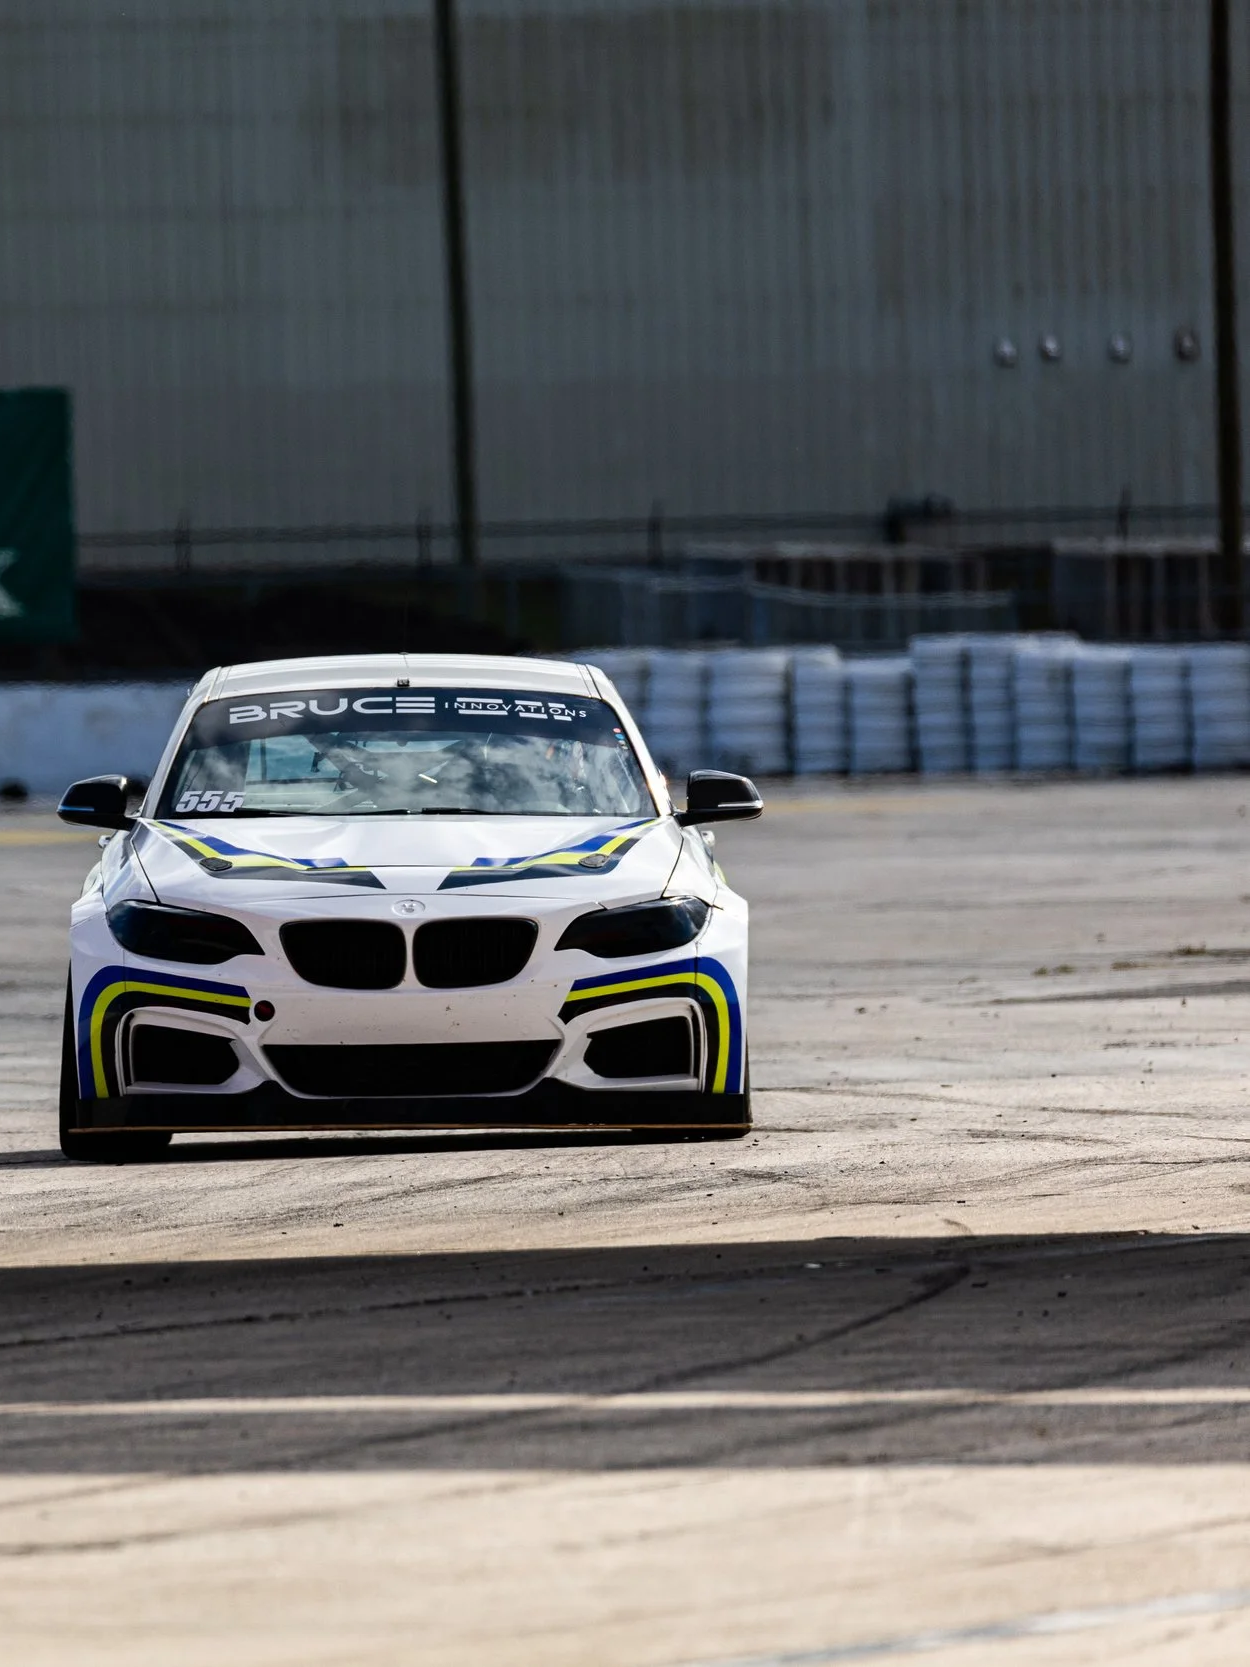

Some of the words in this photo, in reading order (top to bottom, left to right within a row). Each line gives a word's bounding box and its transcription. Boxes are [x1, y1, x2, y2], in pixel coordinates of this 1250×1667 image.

[229, 696, 436, 725] BRUCE
[444, 697, 587, 721] INNOVATIONS
[175, 790, 247, 813] 555
